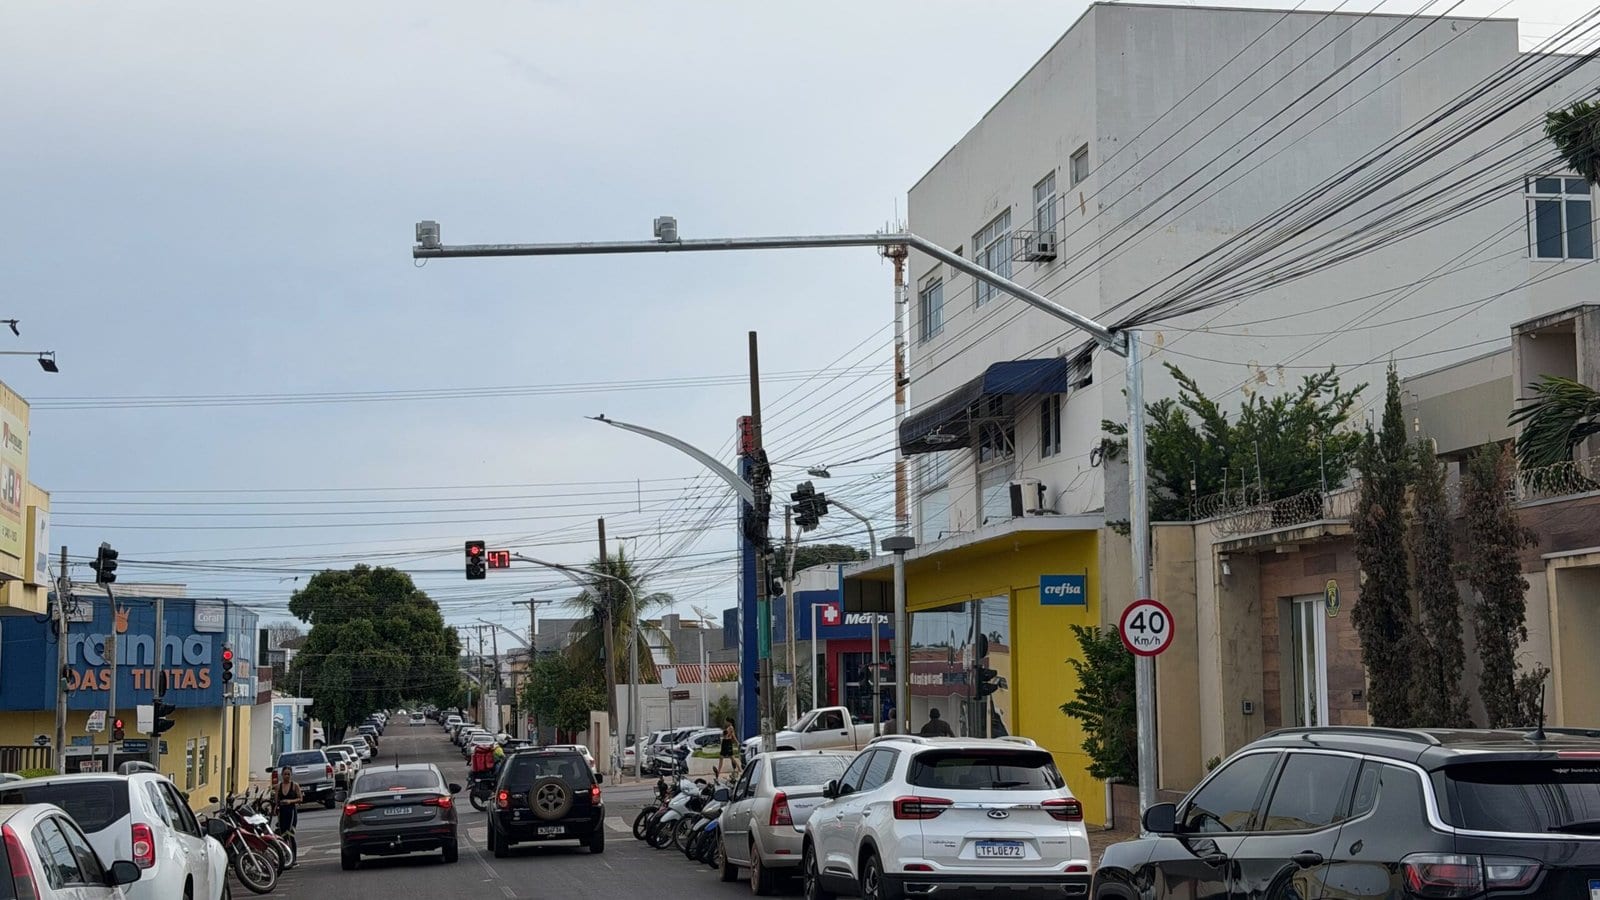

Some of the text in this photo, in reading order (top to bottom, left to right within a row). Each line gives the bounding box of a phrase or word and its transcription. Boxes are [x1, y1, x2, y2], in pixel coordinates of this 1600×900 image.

[489, 551, 509, 567] 47
[1044, 582, 1081, 597] crefisa
[1129, 611, 1165, 634] 40
[1134, 635, 1161, 646] Km/h
[68, 632, 212, 666] rainha
